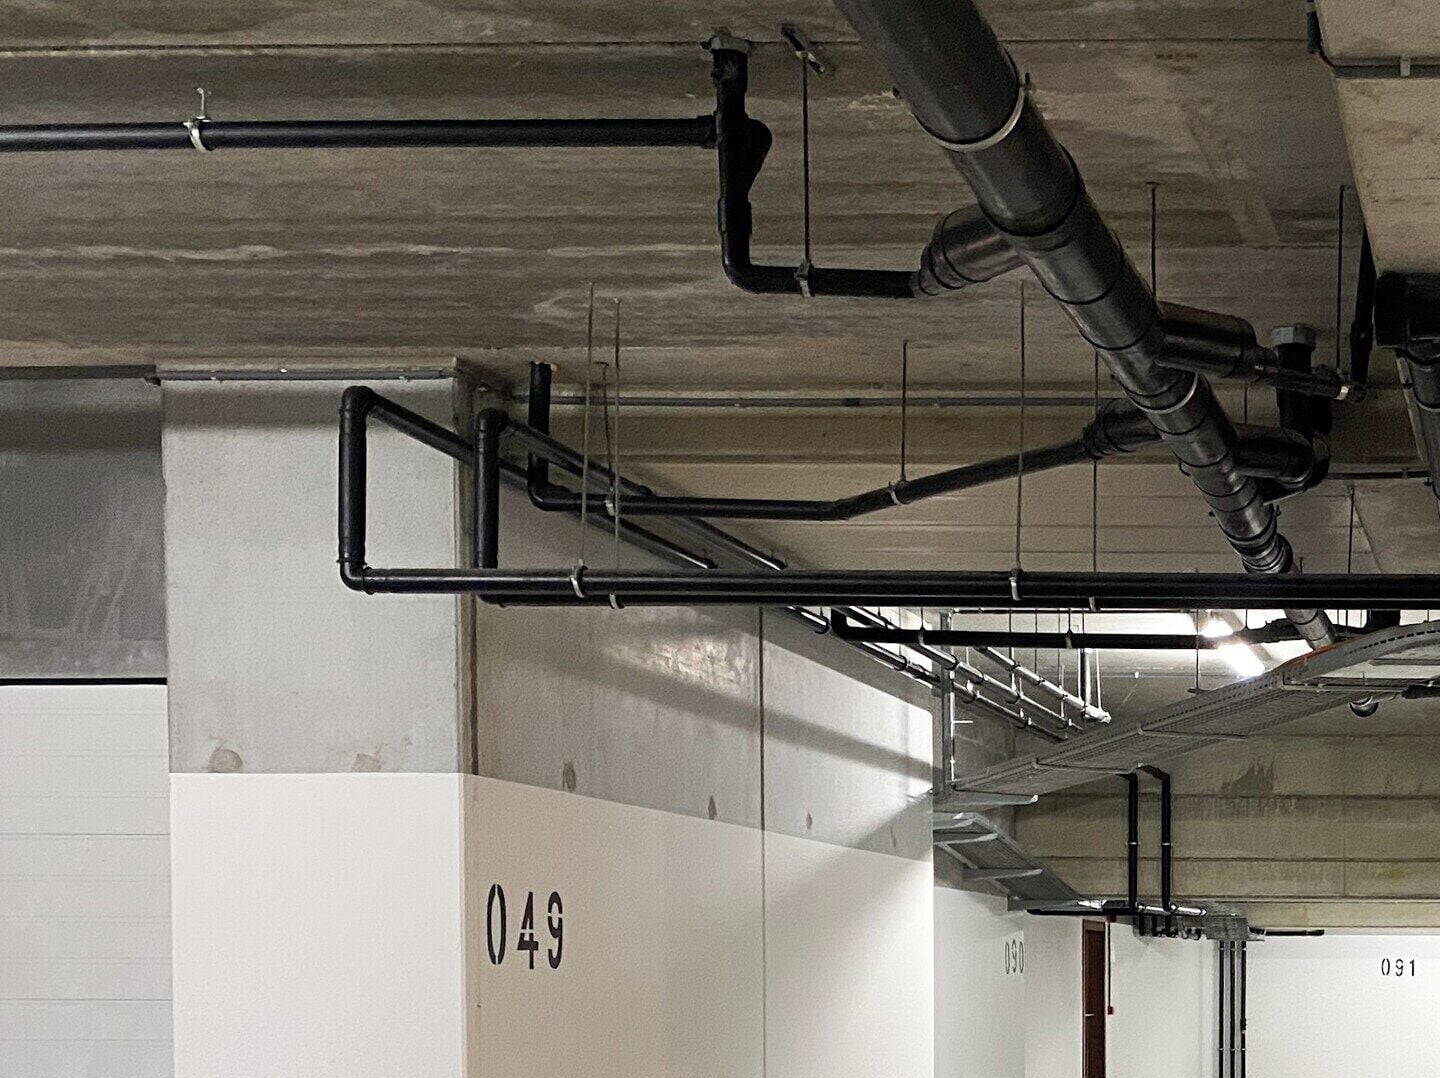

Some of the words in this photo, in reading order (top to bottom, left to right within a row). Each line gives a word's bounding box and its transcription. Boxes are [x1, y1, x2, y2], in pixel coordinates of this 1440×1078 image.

[486, 883, 563, 970] 049
[1004, 938, 1025, 975] 090
[1380, 958, 1415, 977] 091
